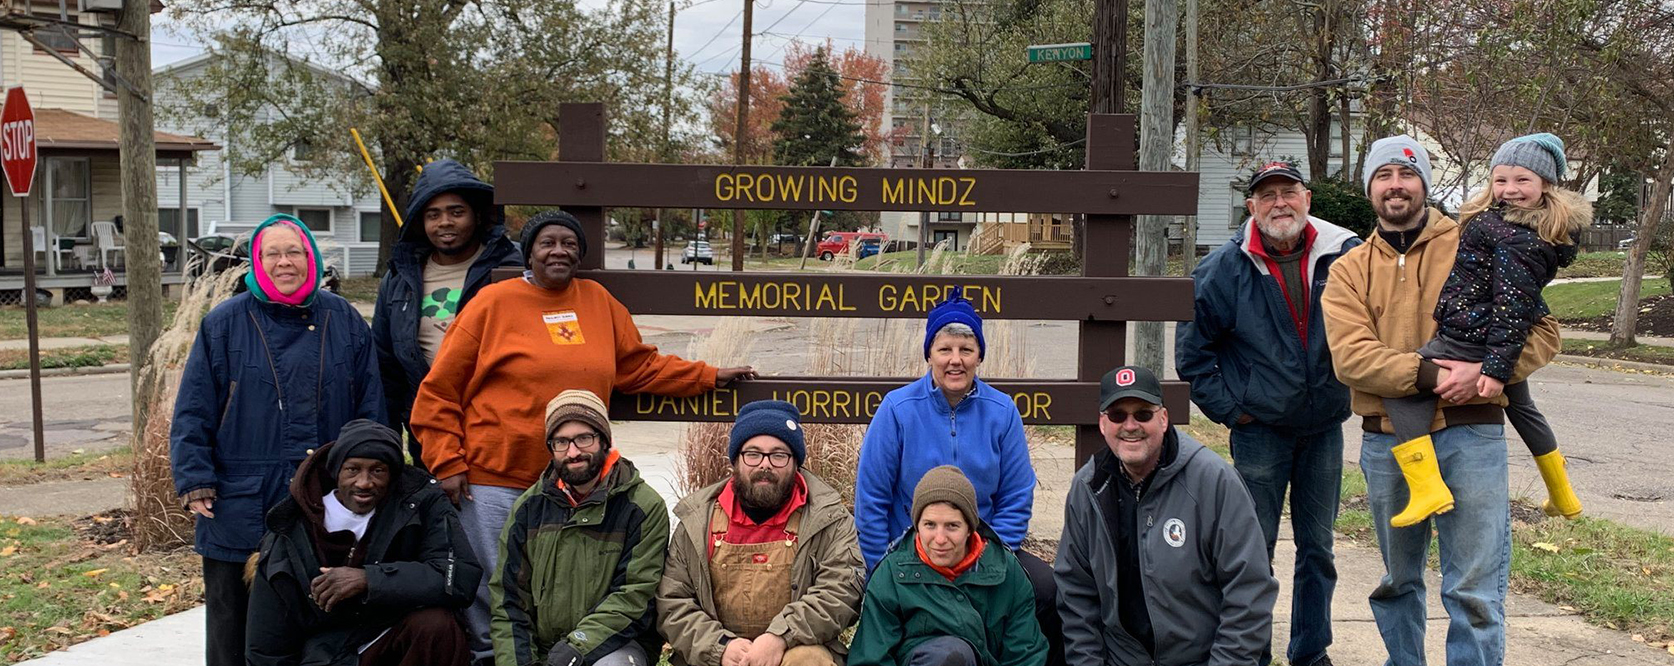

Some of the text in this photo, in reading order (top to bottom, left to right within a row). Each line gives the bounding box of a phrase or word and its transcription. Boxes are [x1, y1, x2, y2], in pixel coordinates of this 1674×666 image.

[1037, 46, 1084, 60] KENYON
[3, 120, 33, 160] STOP
[715, 173, 976, 206] GROWING MINDZ
[695, 281, 857, 311] MEMORIAL
[1014, 392, 1052, 420] OR
